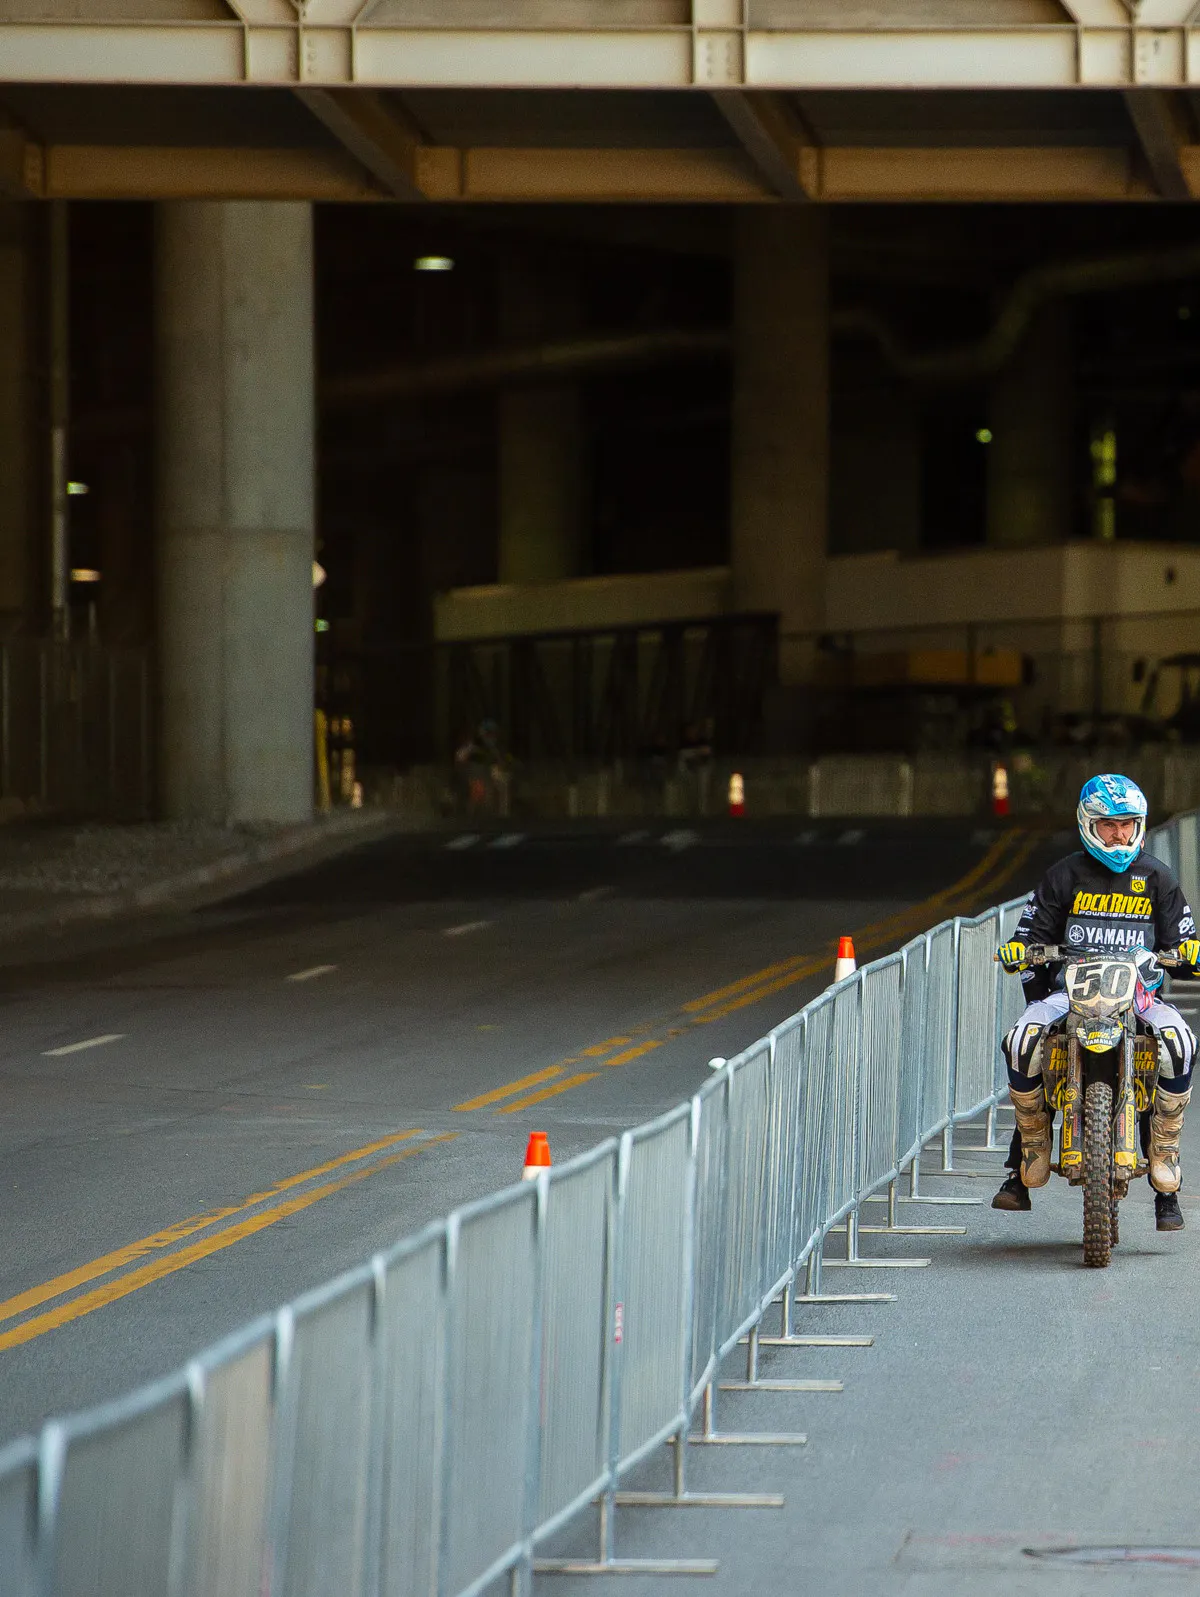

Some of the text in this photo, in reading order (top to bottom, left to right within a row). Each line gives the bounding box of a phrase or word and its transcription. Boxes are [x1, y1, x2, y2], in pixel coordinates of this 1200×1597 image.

[1078, 910, 1150, 919] POWERSPORTS
[1085, 926, 1145, 947] YAMAHA
[1072, 963, 1132, 1001] 50
[1085, 1038, 1113, 1046] YAMAHA
